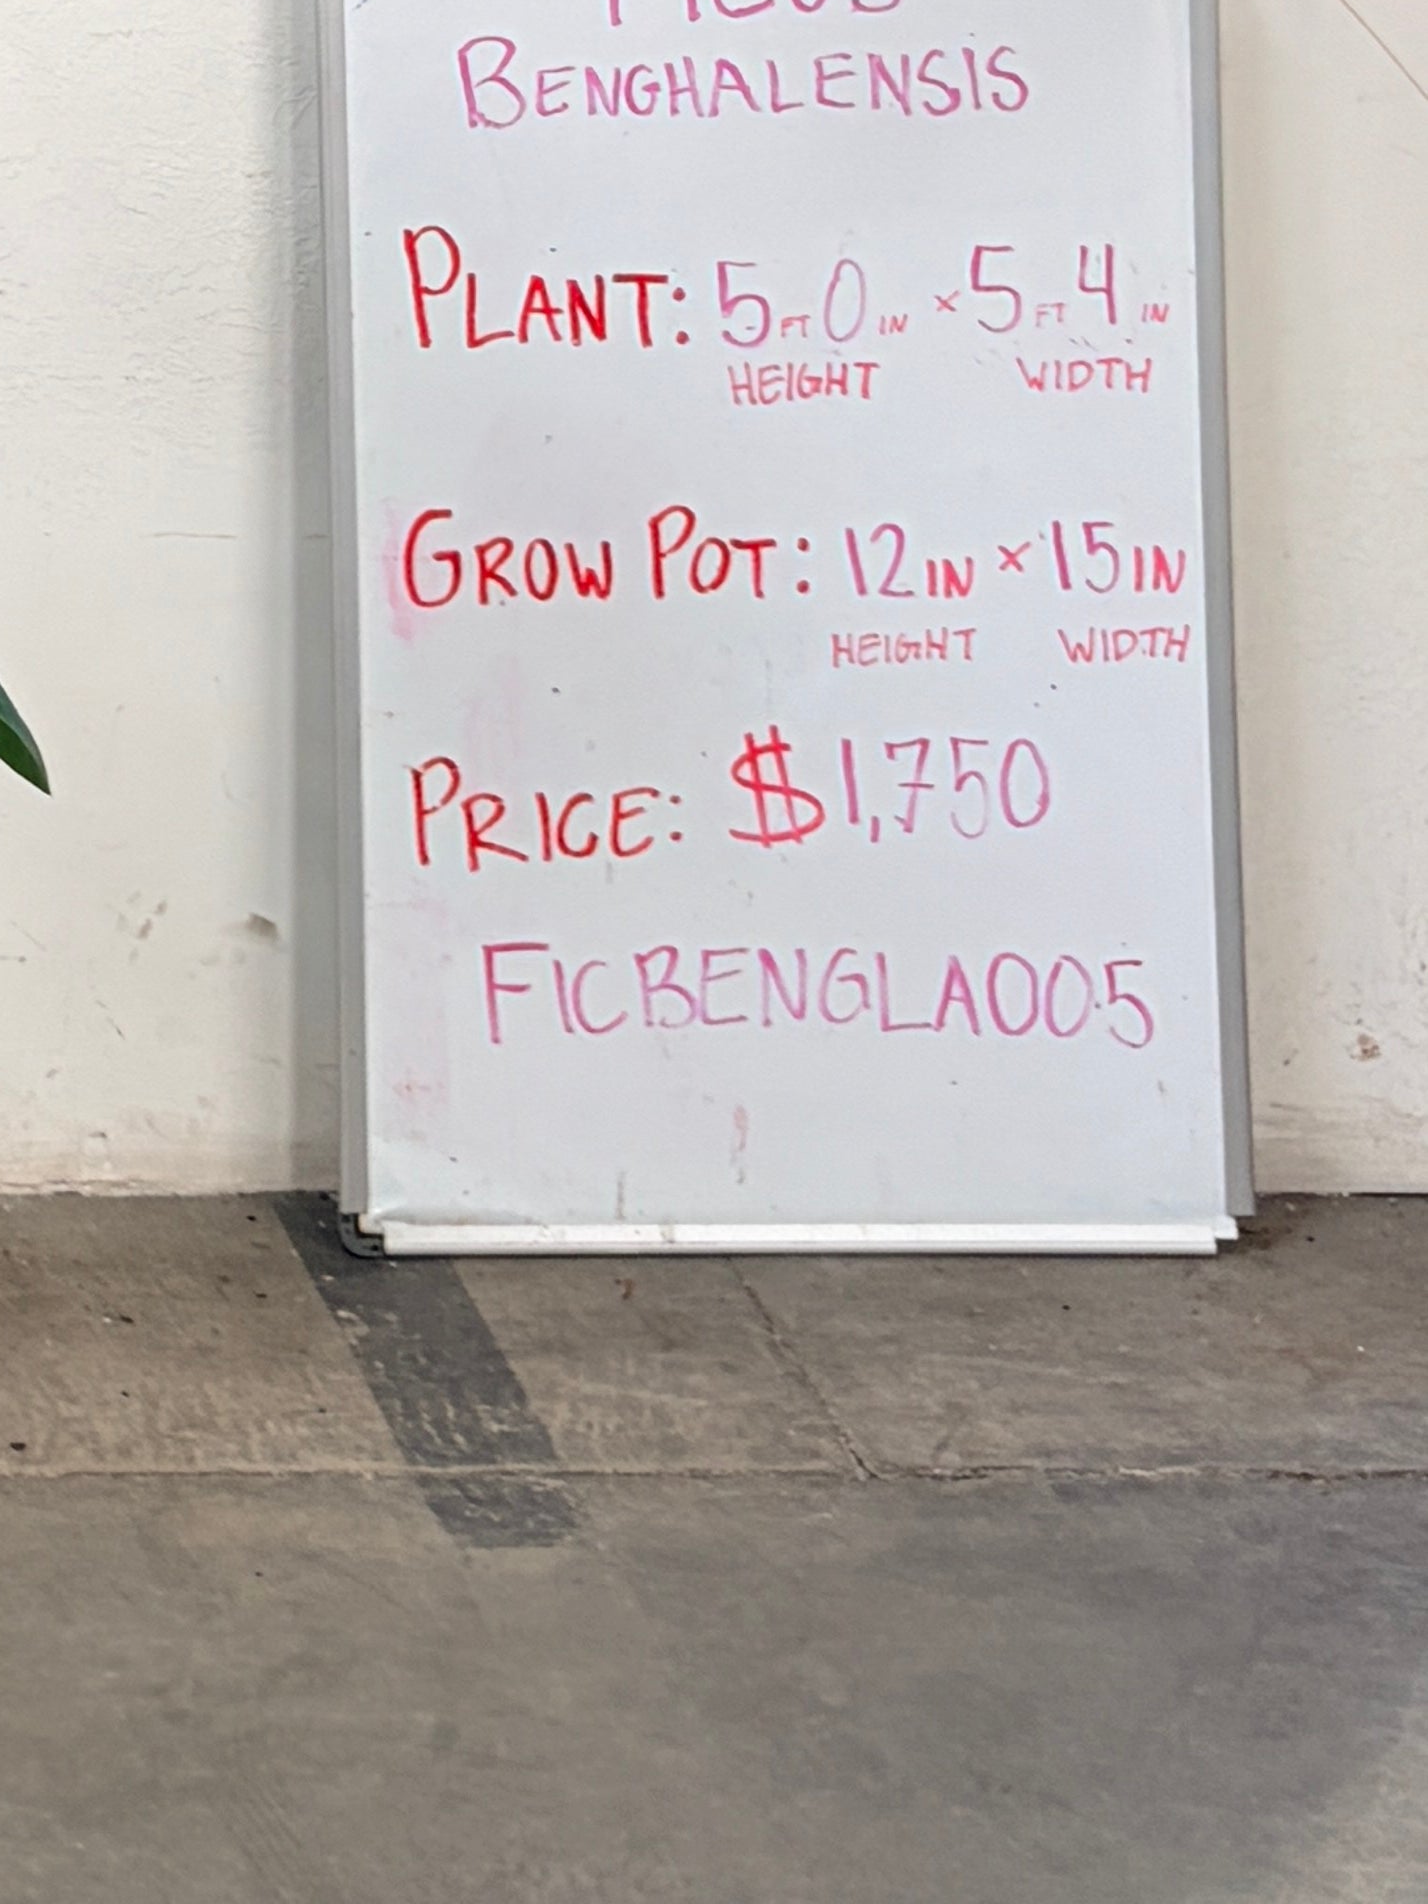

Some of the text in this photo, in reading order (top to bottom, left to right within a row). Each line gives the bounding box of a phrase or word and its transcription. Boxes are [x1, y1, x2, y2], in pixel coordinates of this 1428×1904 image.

[456, 35, 1030, 131] BENGHALENSIS
[401, 224, 690, 350] PLANT:
[727, 355, 1153, 406] HEIGHT WIDTH
[402, 508, 616, 615] GROW
[646, 503, 812, 602] POT:
[830, 624, 1190, 669] HEIGHT WIDTH
[409, 723, 1053, 874] PRICE: $1,750
[480, 940, 1155, 1049] FICBENGLA005
